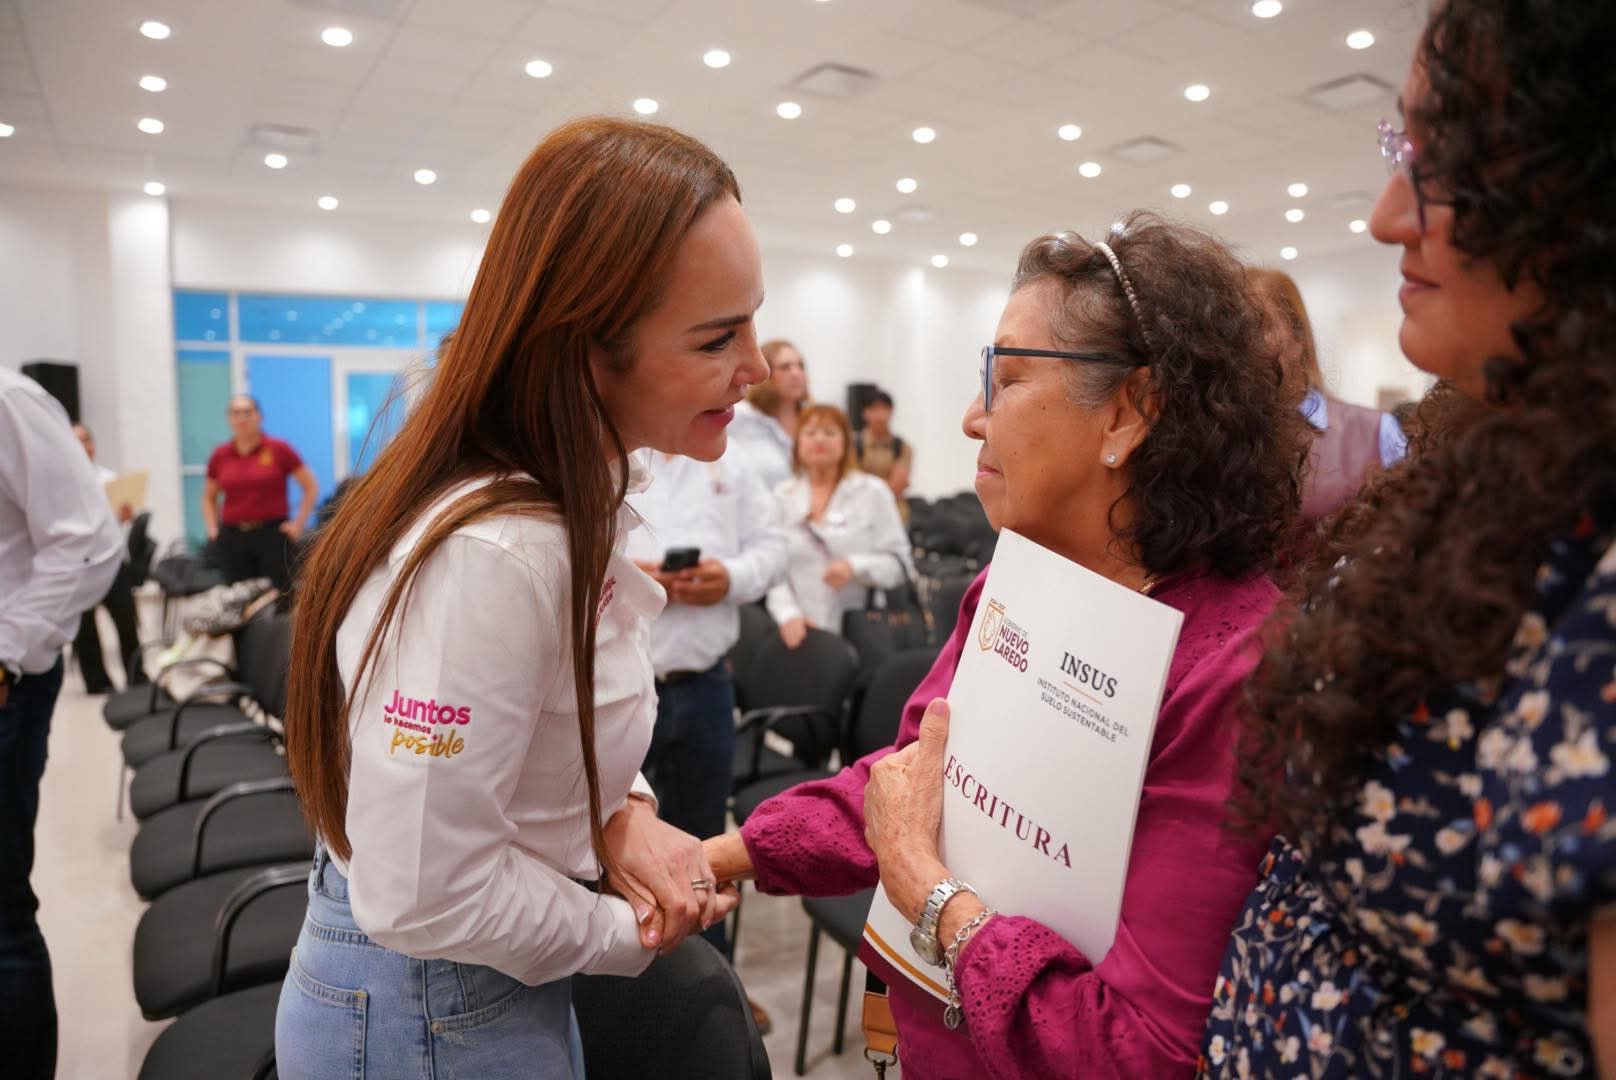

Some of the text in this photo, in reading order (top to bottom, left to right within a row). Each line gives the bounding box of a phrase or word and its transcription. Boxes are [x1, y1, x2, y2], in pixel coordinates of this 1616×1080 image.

[994, 638, 1029, 673] LAREDO
[999, 625, 1030, 655] NUEVO
[1059, 651, 1118, 698] INSUS
[384, 689, 472, 725] Juntos
[393, 716, 432, 734] hacemos
[1037, 677, 1129, 737] INSTITUTO NACIONAL DEL
[1040, 692, 1117, 743] SUELO SUSTENTABLE
[390, 727, 465, 759] posible
[944, 754, 1072, 869] ESCRITURA
